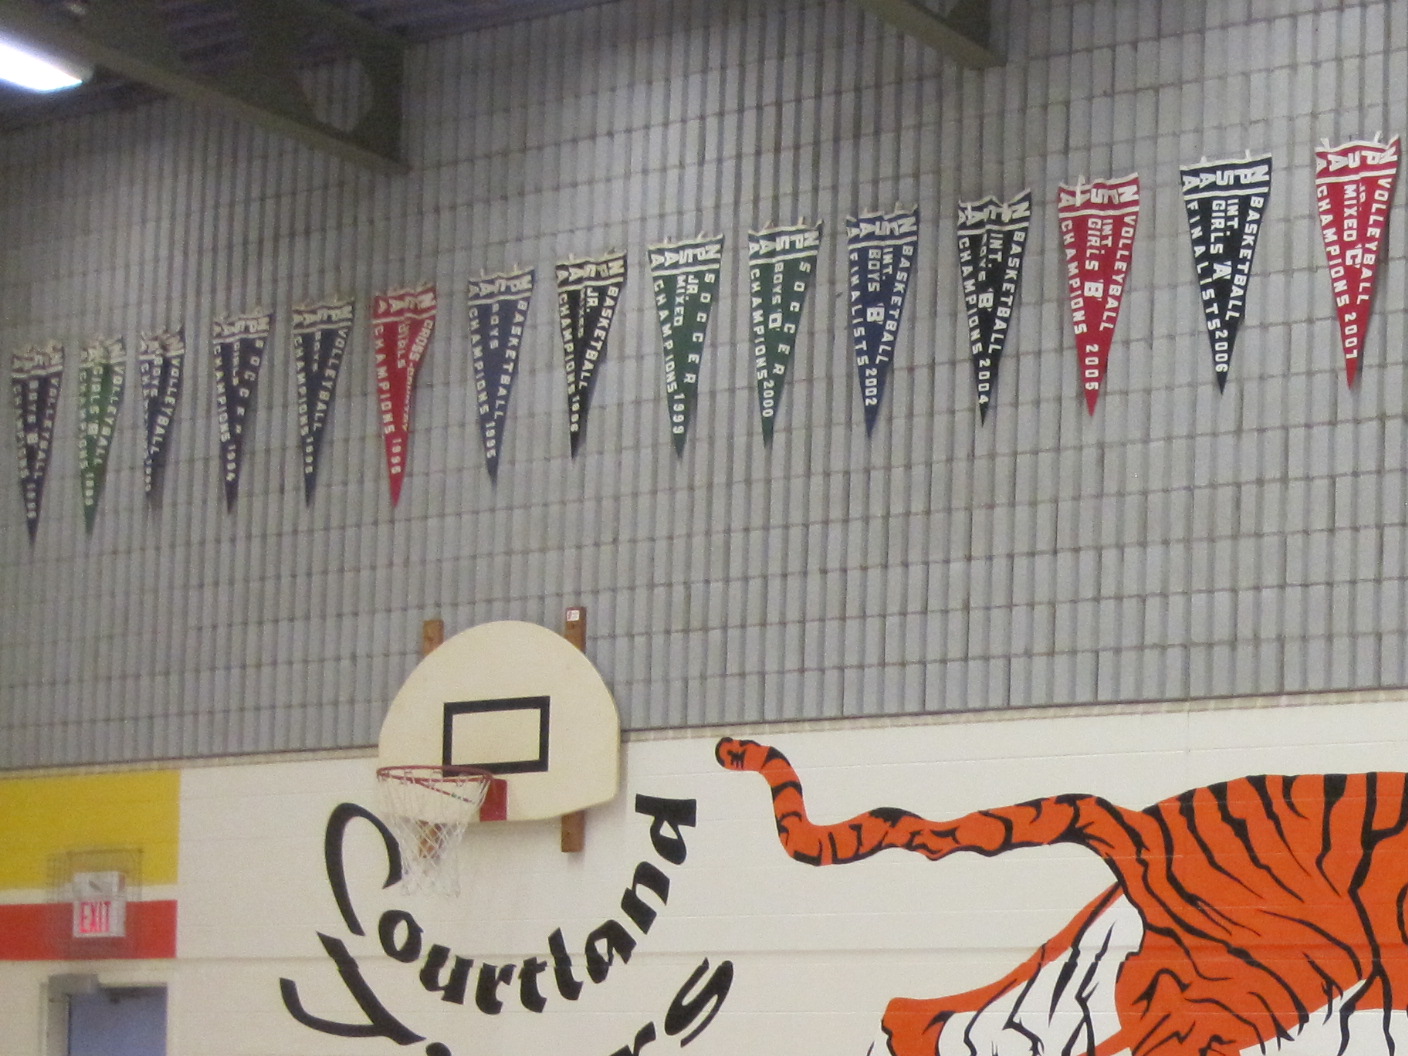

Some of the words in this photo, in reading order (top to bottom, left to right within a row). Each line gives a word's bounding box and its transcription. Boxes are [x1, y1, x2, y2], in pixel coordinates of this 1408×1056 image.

[1086, 218, 1101, 271] GIRLS
[1187, 201, 1221, 330] FINALISTS
[1210, 200, 1225, 254] GIRLS
[1225, 196, 1264, 320] BASKETBALL
[1317, 185, 1349, 307] CHAMPIONS
[1344, 185, 1357, 242] MIXED
[1357, 178, 1392, 305] VOLLEYBALL
[674, 275, 686, 326] MIXED
[751, 269, 768, 380] CHAMPIONS
[772, 262, 784, 305] BOYS
[773, 262, 811, 375] SOCCER
[850, 253, 869, 366] FINALISTS
[868, 249, 881, 292] BOYS
[876, 245, 913, 364] BASKETBALL
[959, 237, 982, 354] CHAMPIONS
[989, 231, 1025, 354] BASKETBALL
[1061, 220, 1087, 335] CHAMPIONS
[1100, 215, 1137, 332] VOLLEYBALL
[312, 329, 348, 431] VOLLEYBALL
[374, 325, 396, 434] CHAMPIONS
[469, 307, 489, 415] CHAMPIONS
[494, 300, 528, 420] BASKETBALL
[559, 294, 575, 395] CHAMPIONS
[579, 286, 619, 389] BASKETBALL
[655, 280, 678, 393] CHAMPIONS
[684, 273, 715, 384] SOCCER
[978, 358, 990, 404] 2004
[1085, 344, 1099, 391] 2005
[1215, 329, 1229, 373] 2006
[1344, 312, 1358, 359] 2007
[150, 358, 180, 455] VOLLEYBALL
[763, 379, 774, 417] 2000
[865, 368, 878, 406] 2002
[79, 900, 112, 934] EXIT
[325, 793, 697, 1015] Courtland
